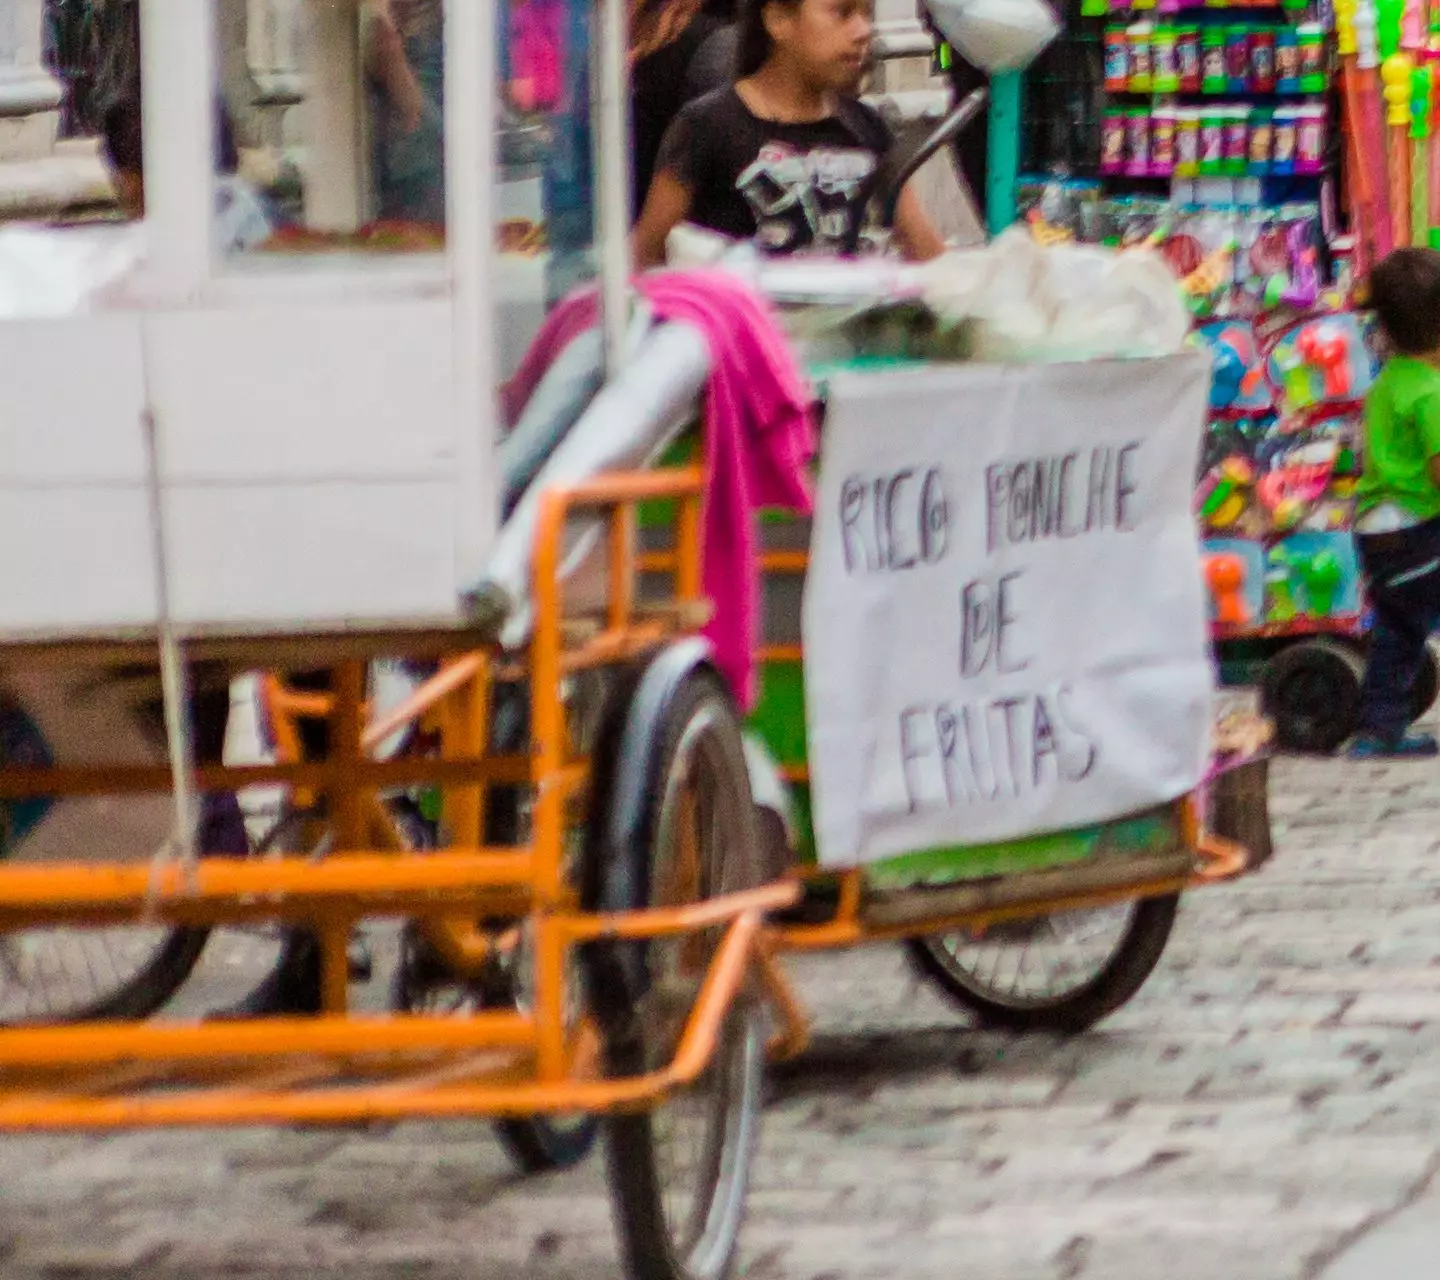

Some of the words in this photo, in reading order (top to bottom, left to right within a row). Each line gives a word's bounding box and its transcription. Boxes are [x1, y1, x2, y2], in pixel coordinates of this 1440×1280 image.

[839, 467, 952, 574] RICO
[959, 569, 1034, 680] DE
[899, 685, 1098, 814] FRUTAS
